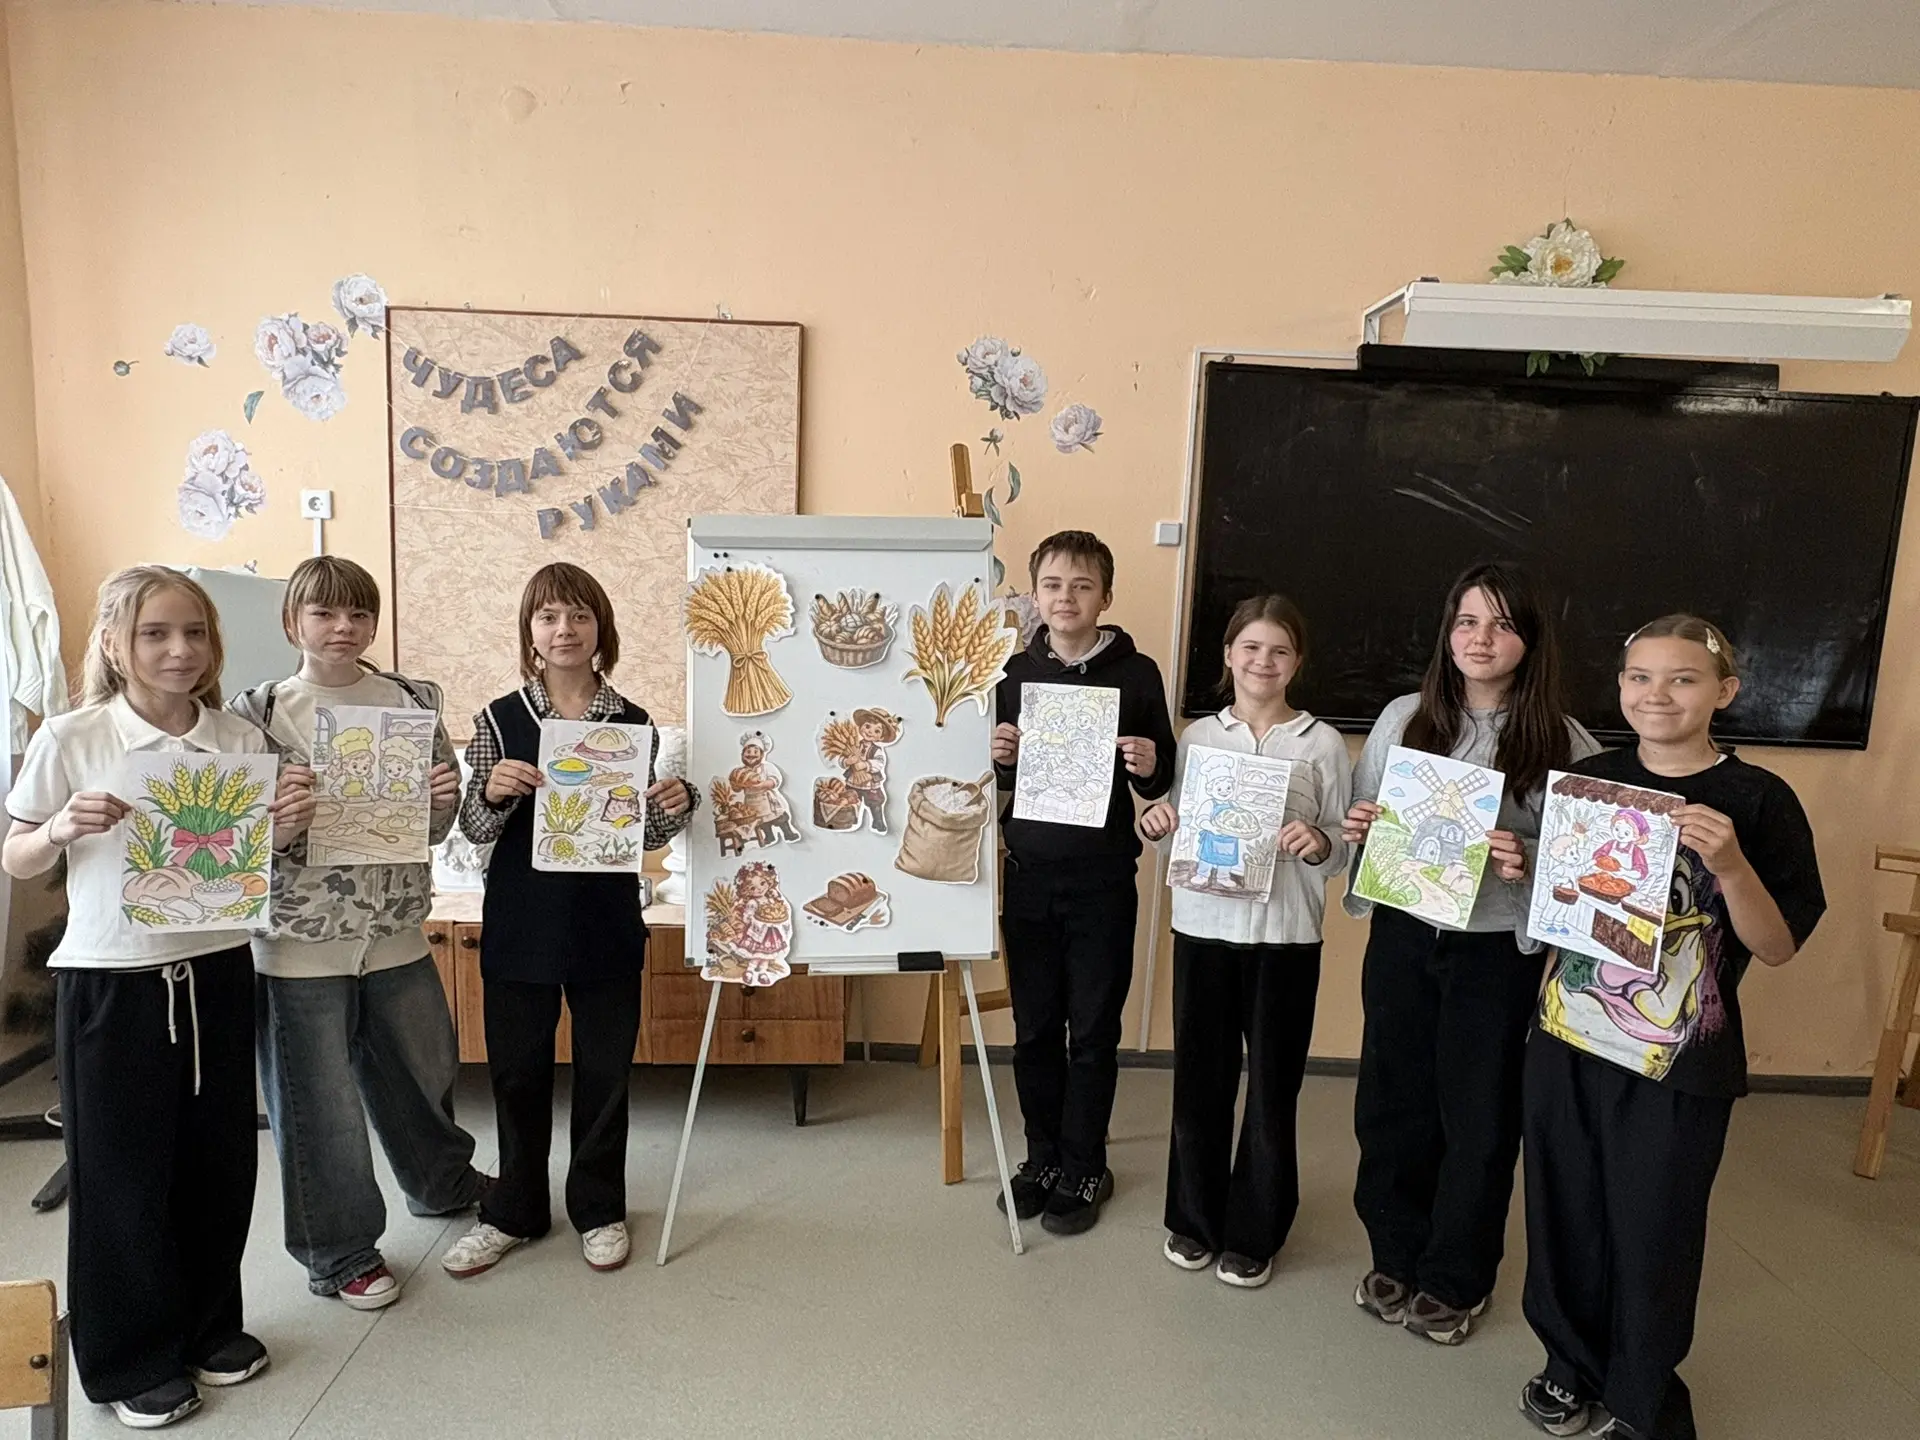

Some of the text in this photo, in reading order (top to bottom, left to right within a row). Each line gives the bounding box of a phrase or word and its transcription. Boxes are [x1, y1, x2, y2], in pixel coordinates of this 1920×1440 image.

[399, 328, 662, 498] СОЗДАЮТСЯ
[402, 336, 584, 415] ЧУДЕСА
[536, 391, 702, 540] РУКАМИ
